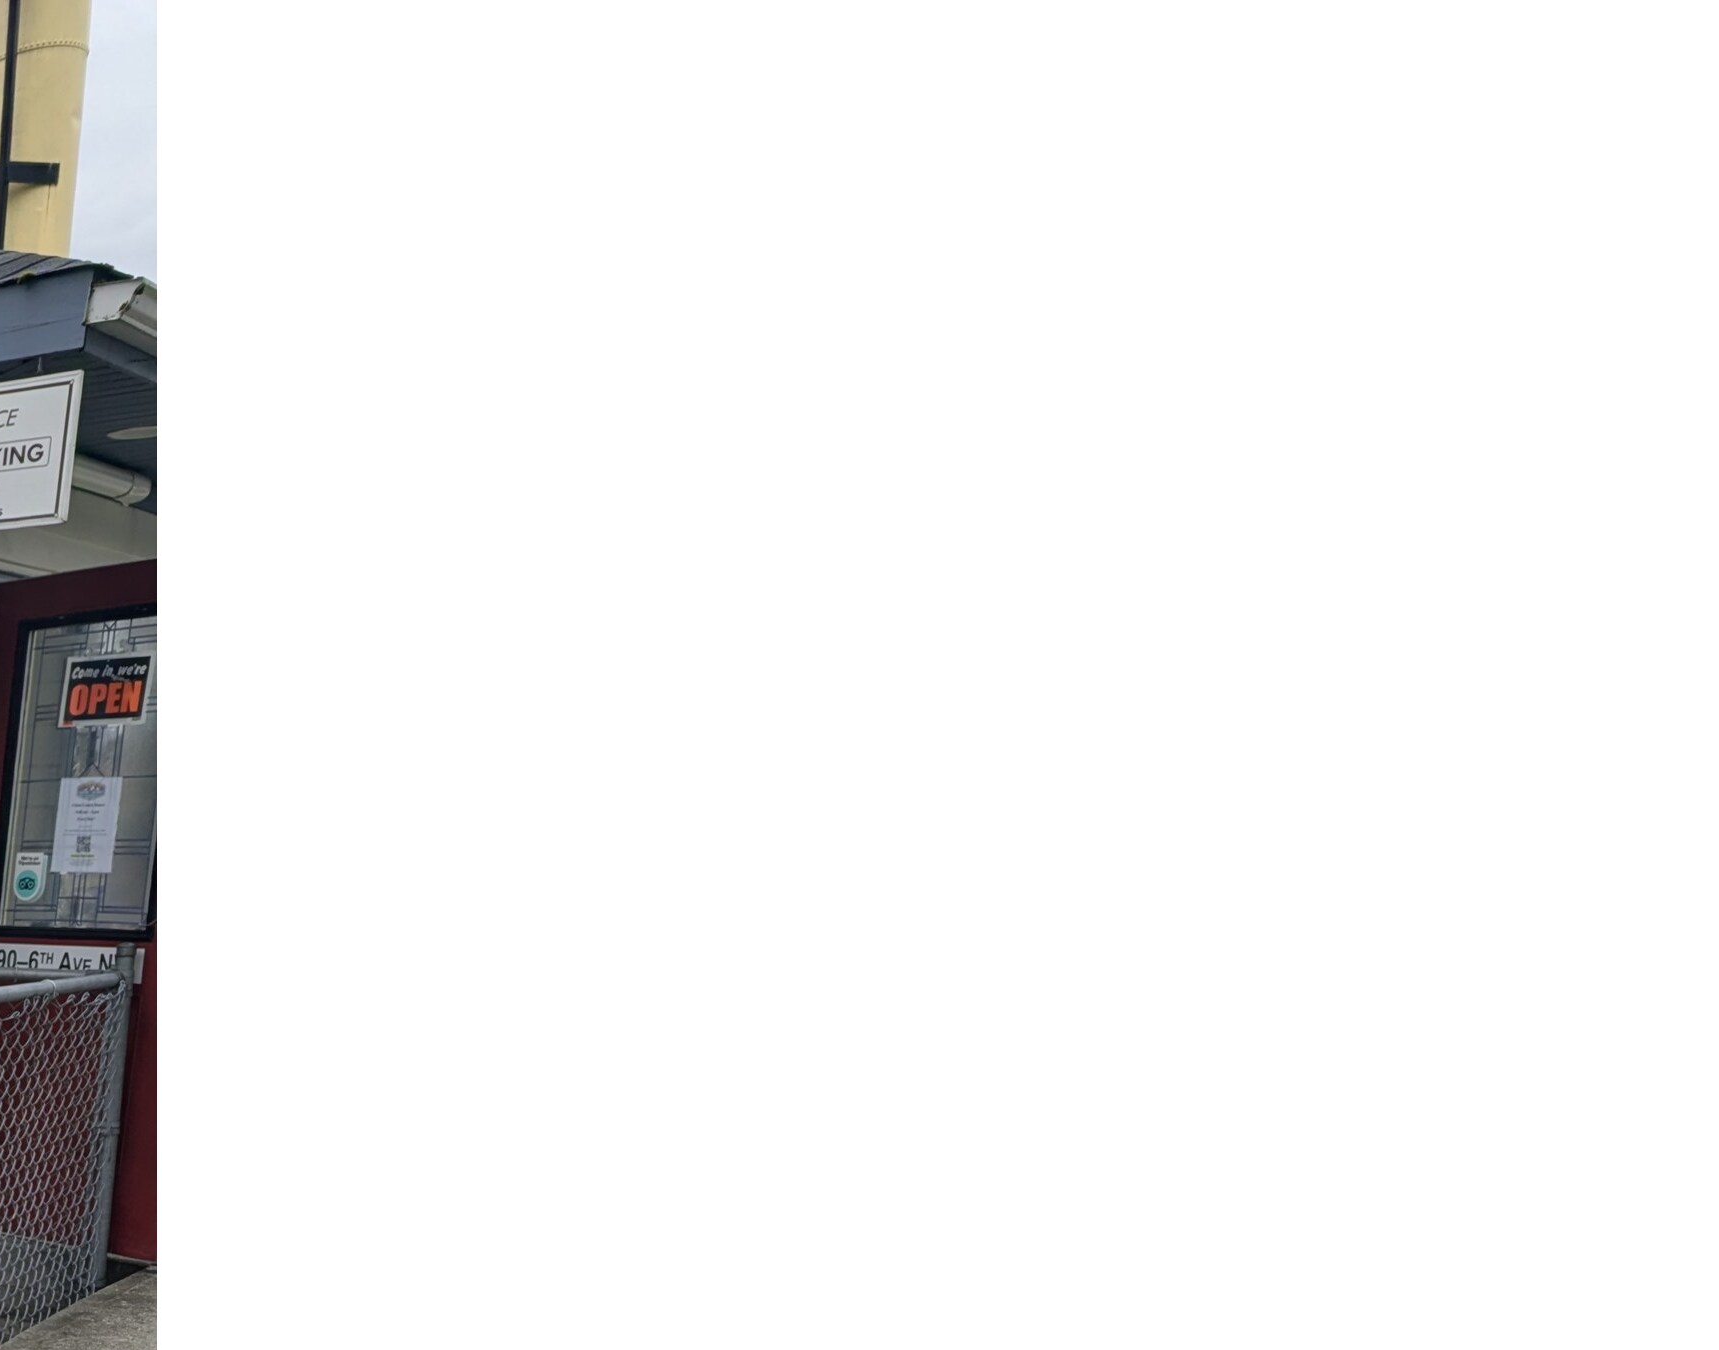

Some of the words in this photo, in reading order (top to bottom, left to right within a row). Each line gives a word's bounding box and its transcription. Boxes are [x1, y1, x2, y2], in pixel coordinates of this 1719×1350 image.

[71, 666, 100, 680] Come
[117, 663, 148, 676] we're
[69, 680, 142, 716] OPEN
